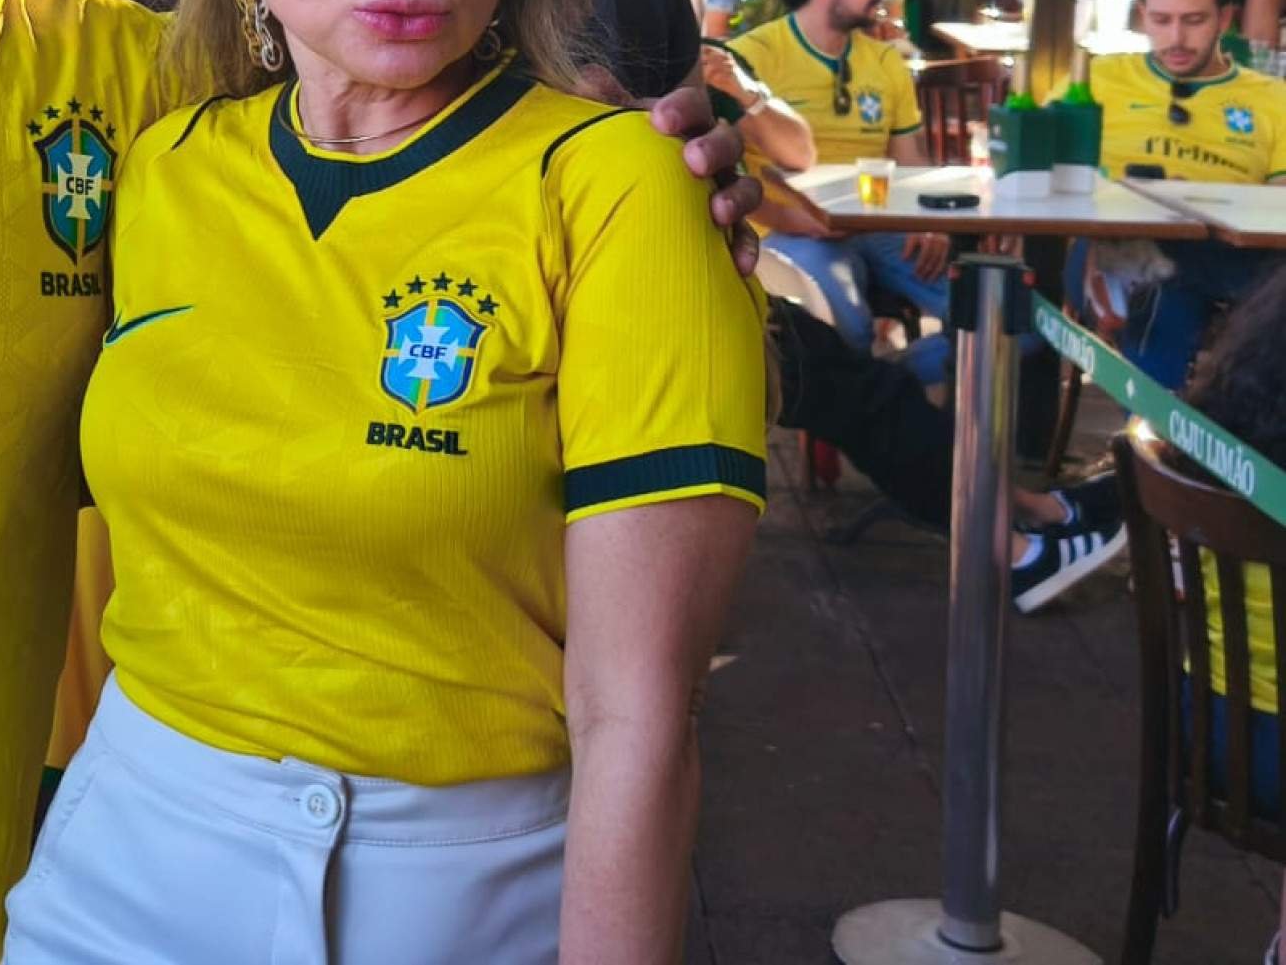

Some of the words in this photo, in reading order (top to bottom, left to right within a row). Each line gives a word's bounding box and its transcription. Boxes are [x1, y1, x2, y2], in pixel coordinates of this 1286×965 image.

[65, 176, 95, 195] CBF
[41, 272, 101, 296] BRASIL
[409, 344, 448, 359] CBF
[366, 421, 468, 456] BRASIL
